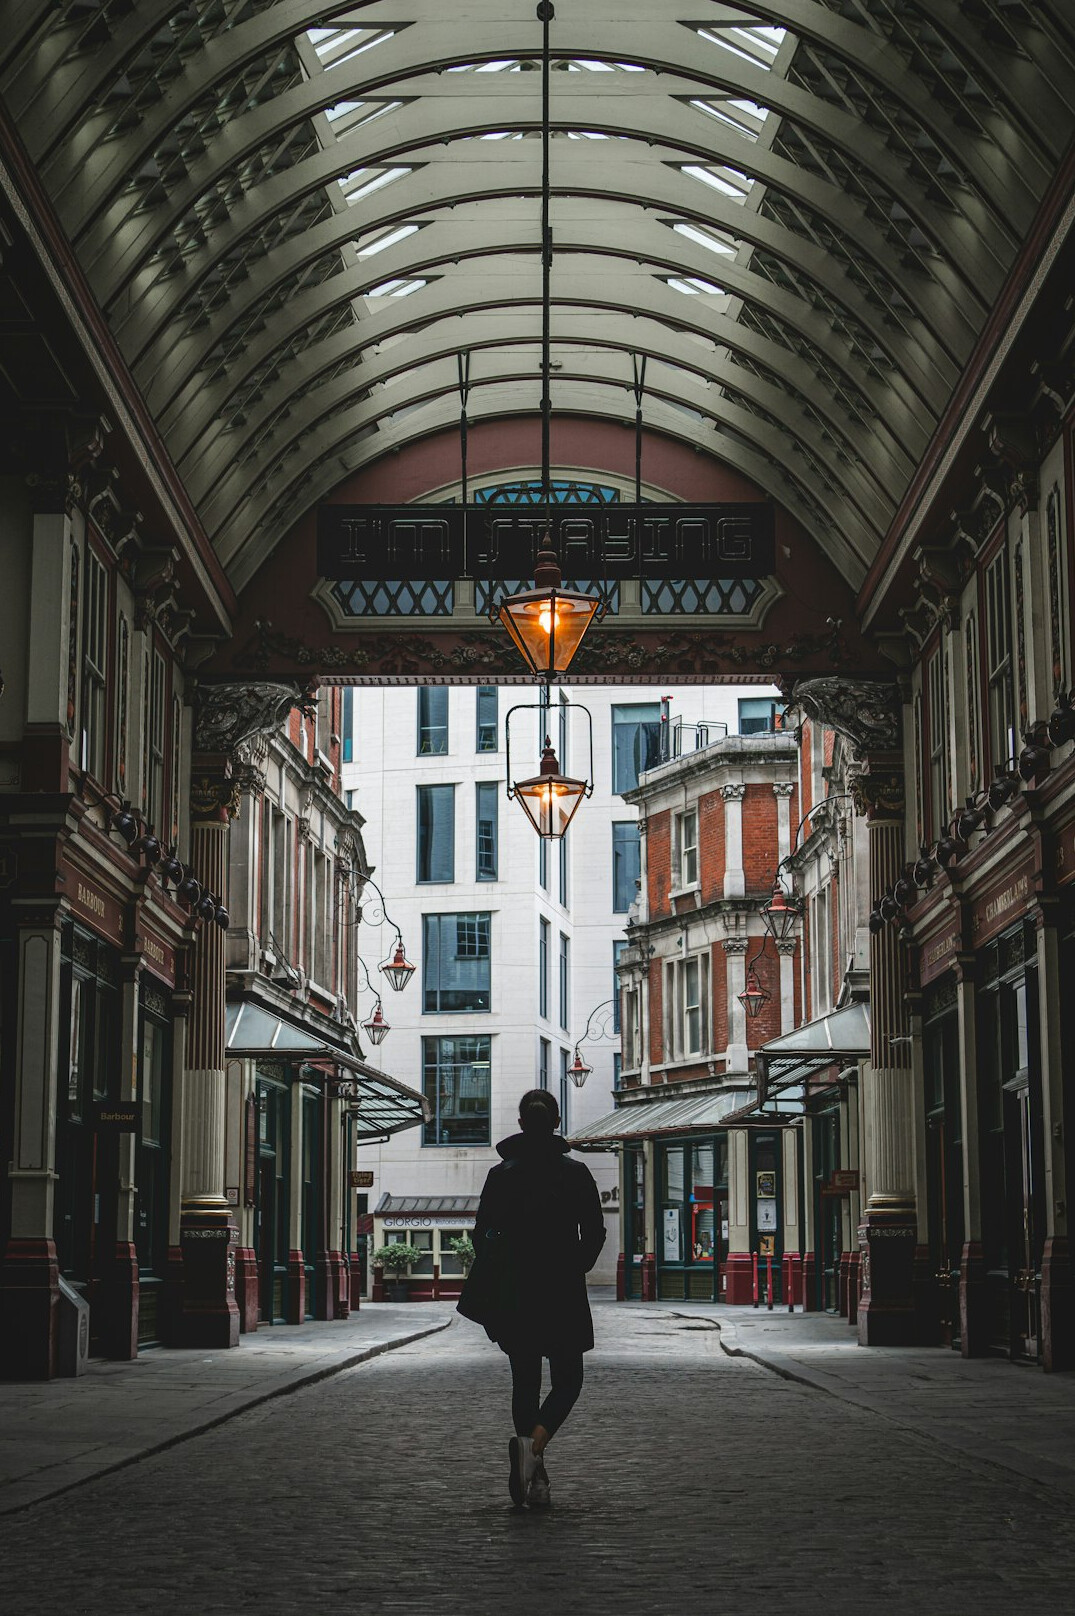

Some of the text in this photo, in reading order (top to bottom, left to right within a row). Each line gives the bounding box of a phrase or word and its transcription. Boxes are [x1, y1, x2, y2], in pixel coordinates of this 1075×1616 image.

[339, 516, 752, 563] I'M STAYING
[77, 882, 105, 919] BARBOUR
[143, 936, 165, 966] BARBOUR
[100, 1112, 135, 1120] Barbour
[383, 1217, 431, 1227] GIORGIO
